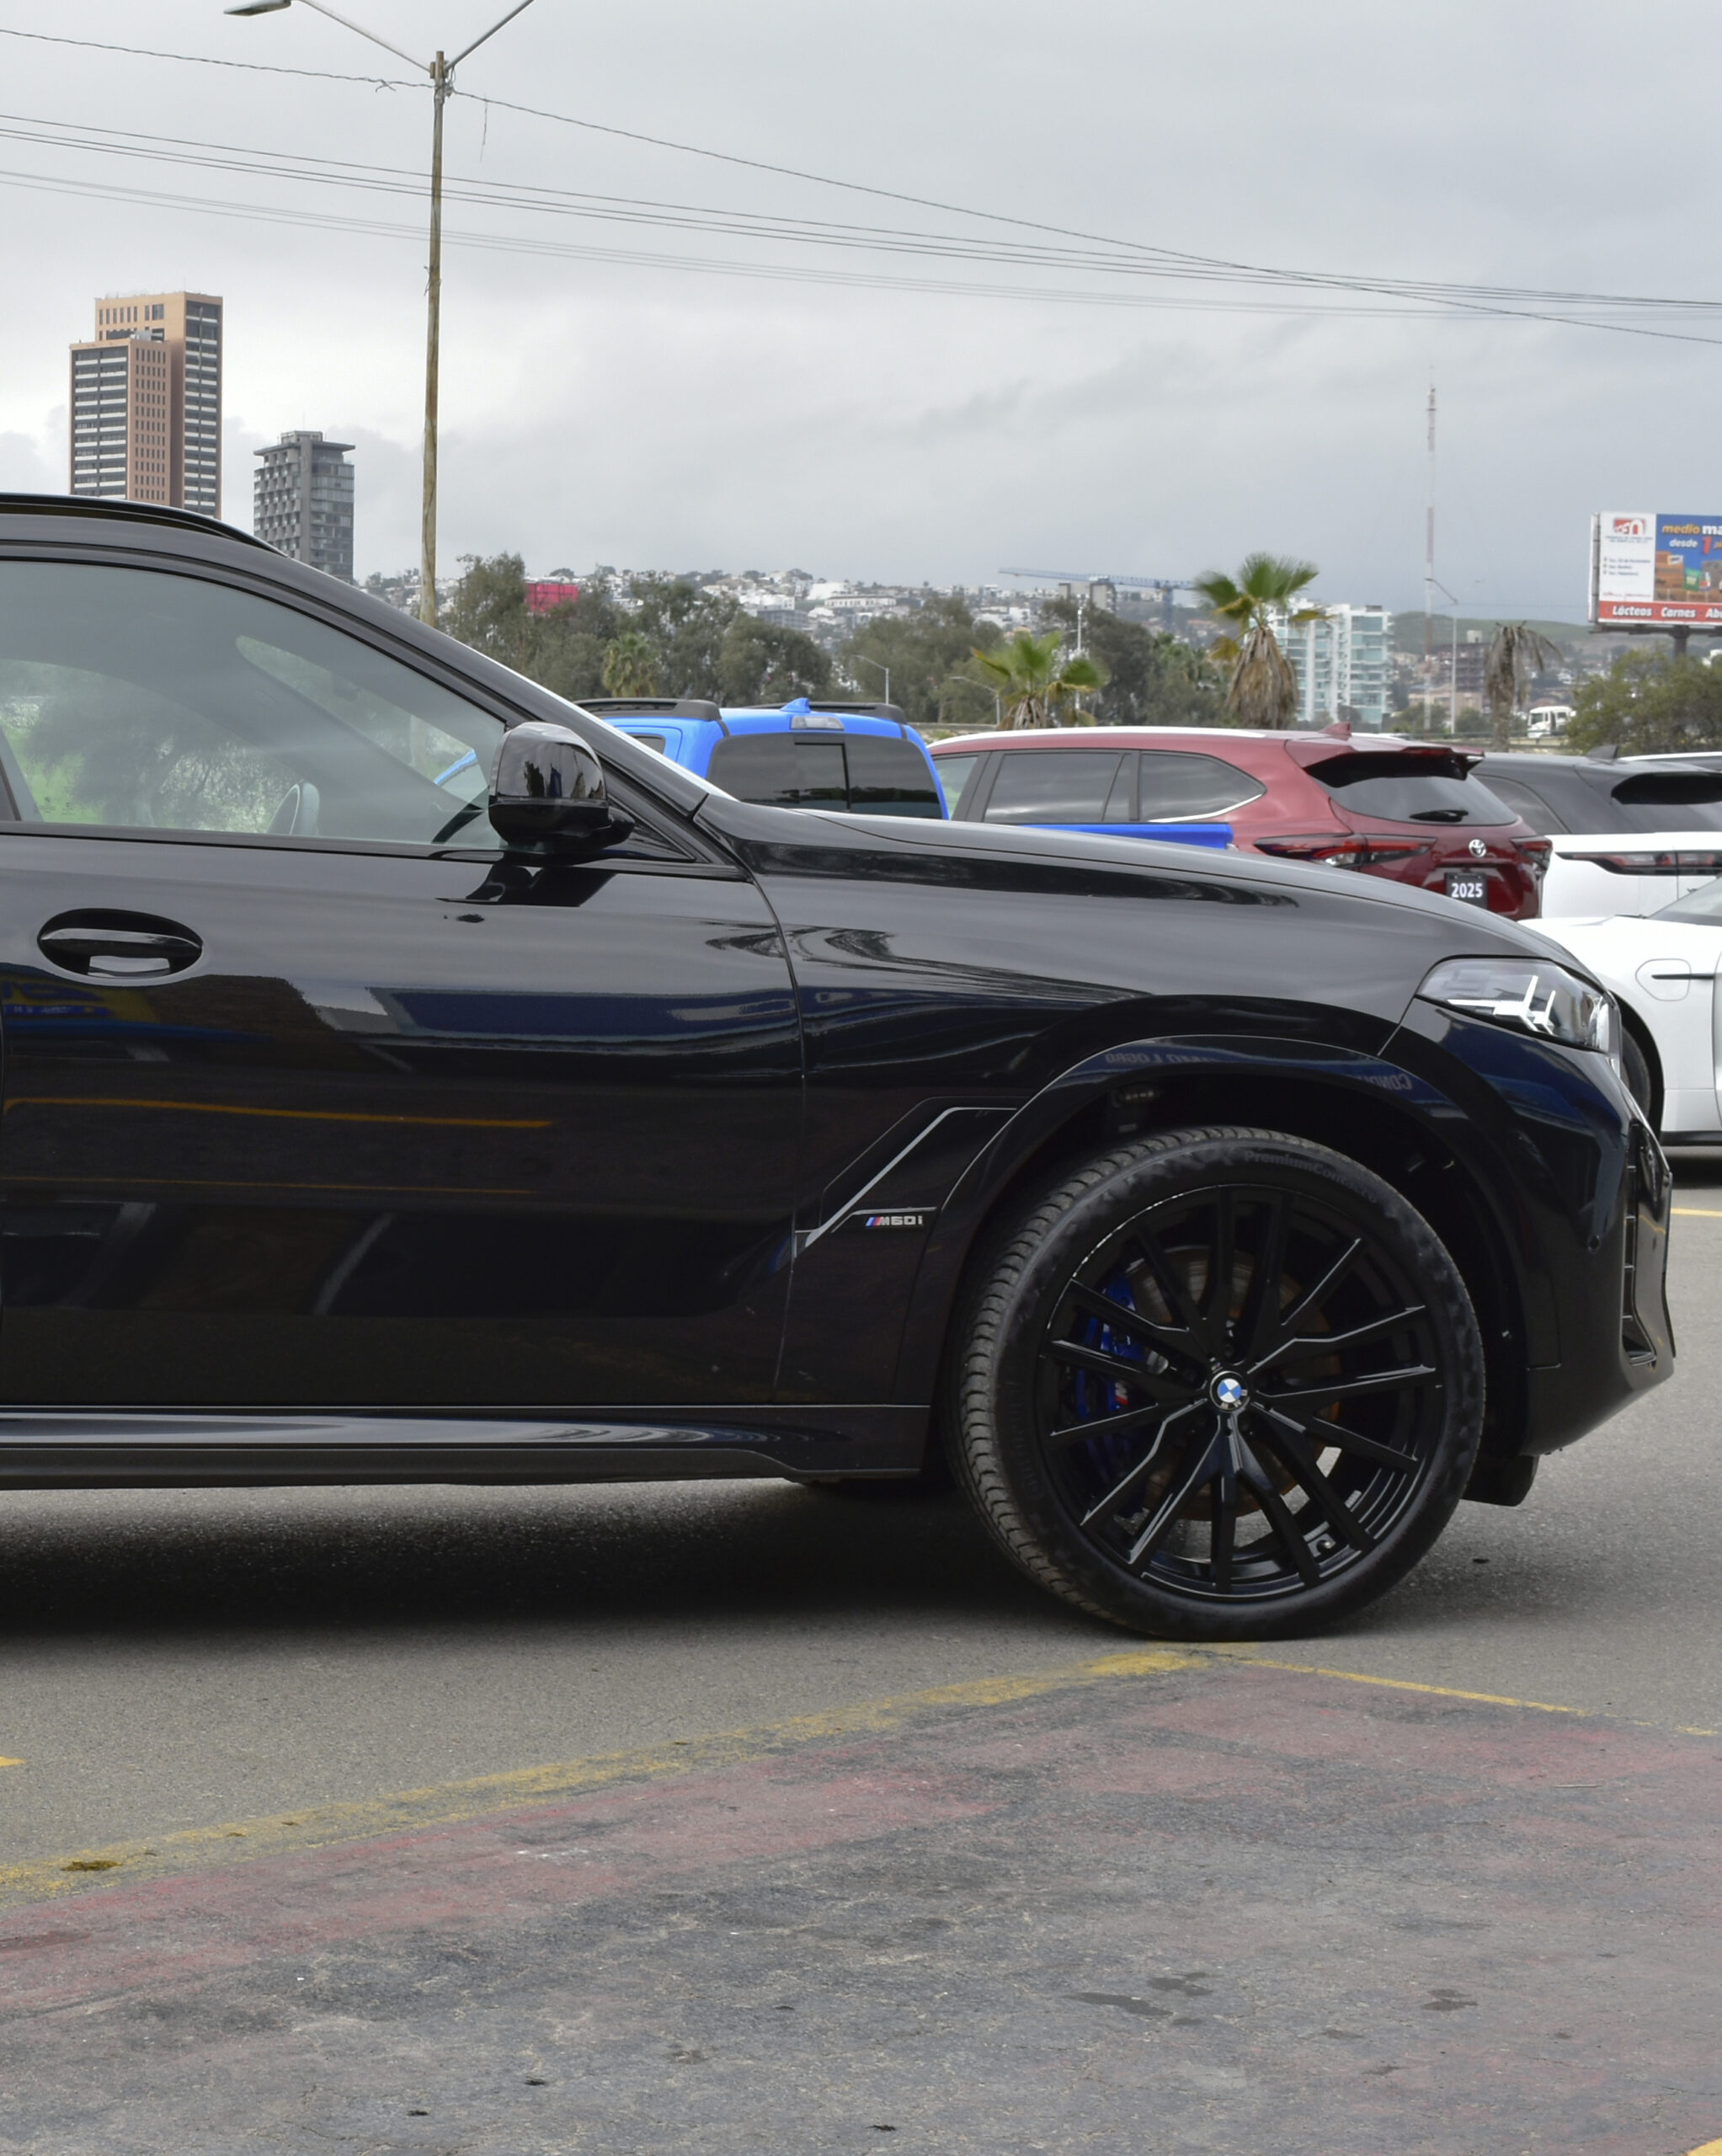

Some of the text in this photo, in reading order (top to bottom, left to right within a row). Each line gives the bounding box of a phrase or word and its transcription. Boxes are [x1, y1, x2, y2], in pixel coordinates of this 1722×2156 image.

[1662, 524, 1700, 534] medio
[1670, 538, 1698, 547] desde
[1703, 536, 1711, 554] 1
[1613, 605, 1652, 616] Lácteos
[1661, 607, 1696, 618] Carnes
[1451, 883, 1484, 899] 2025
